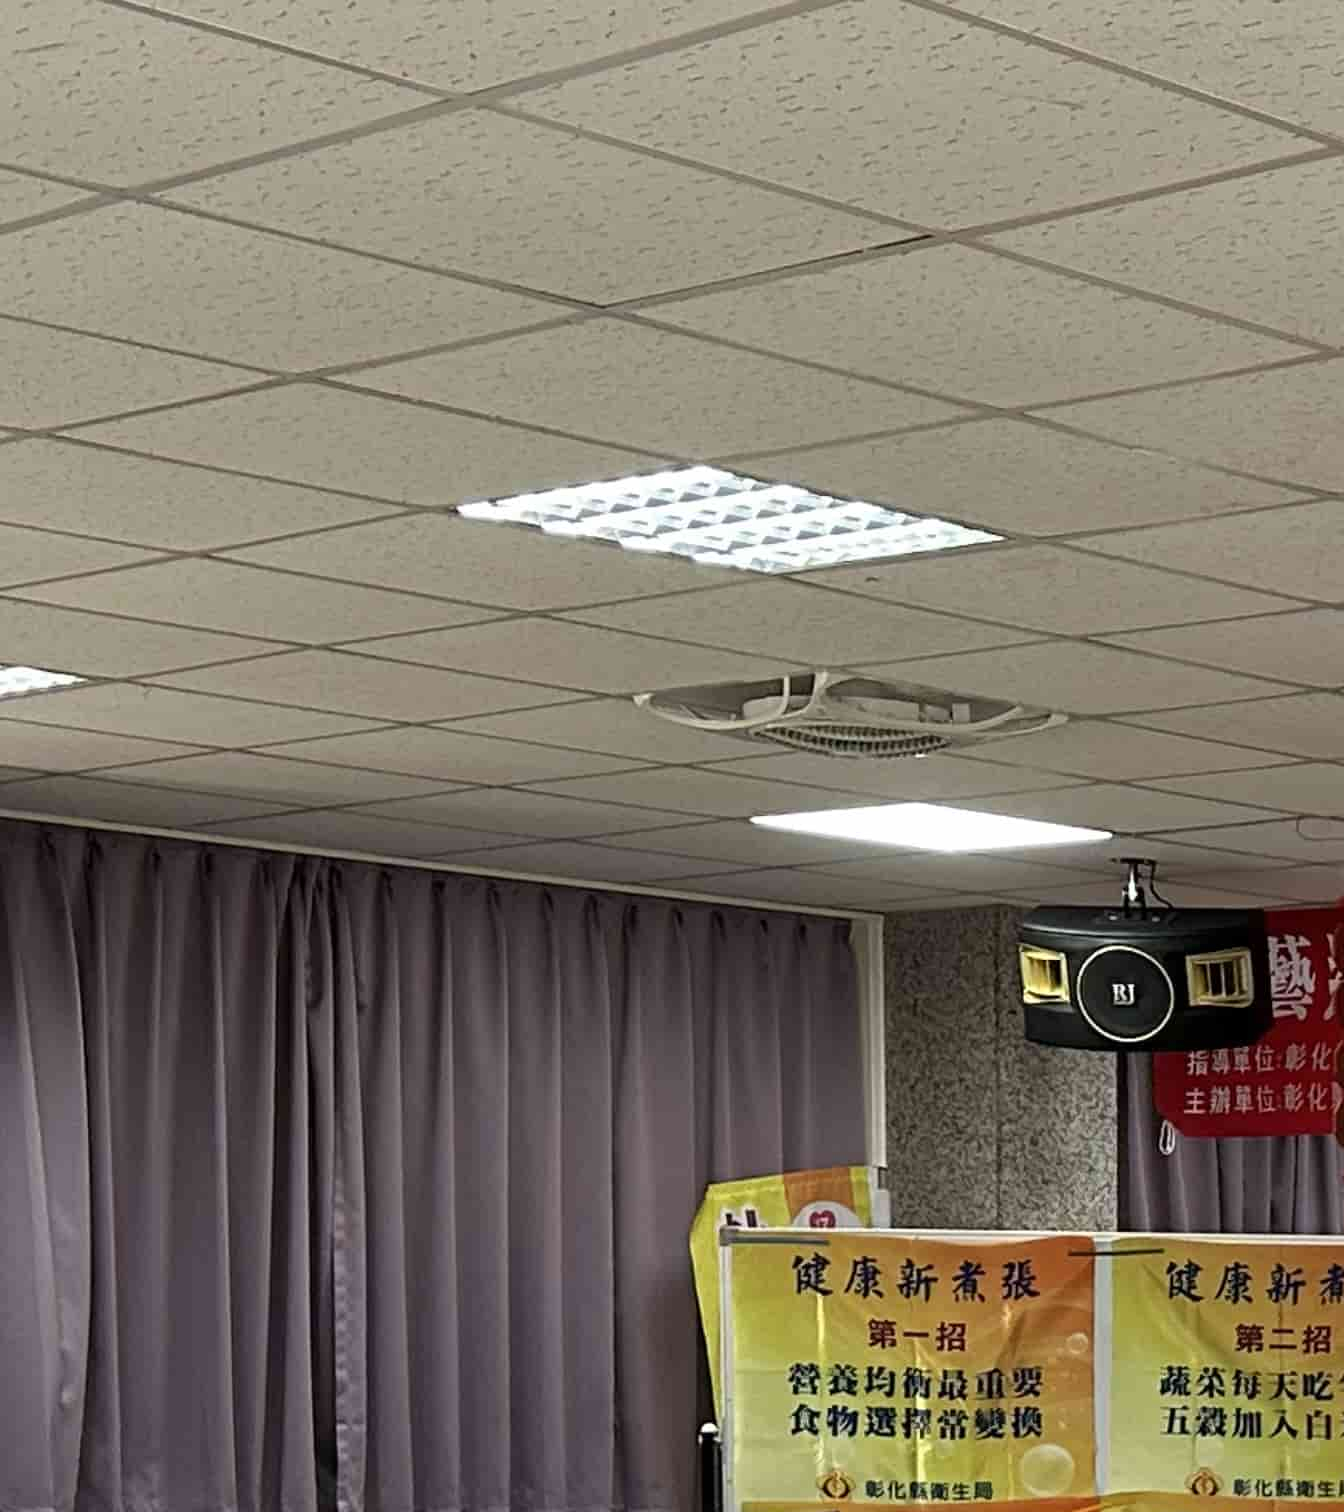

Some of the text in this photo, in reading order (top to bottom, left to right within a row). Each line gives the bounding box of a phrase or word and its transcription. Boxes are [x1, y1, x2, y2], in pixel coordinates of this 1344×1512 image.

[792, 1253, 1041, 1302] 健康新煮張
[867, 1320, 968, 1354] 第一招
[1235, 1323, 1333, 1356] 第二招
[788, 1363, 1044, 1402] 營養均衡最重要
[789, 1405, 1043, 1442] 食物選擇常變換
[865, 1478, 993, 1502] 彰化縣衛生局
